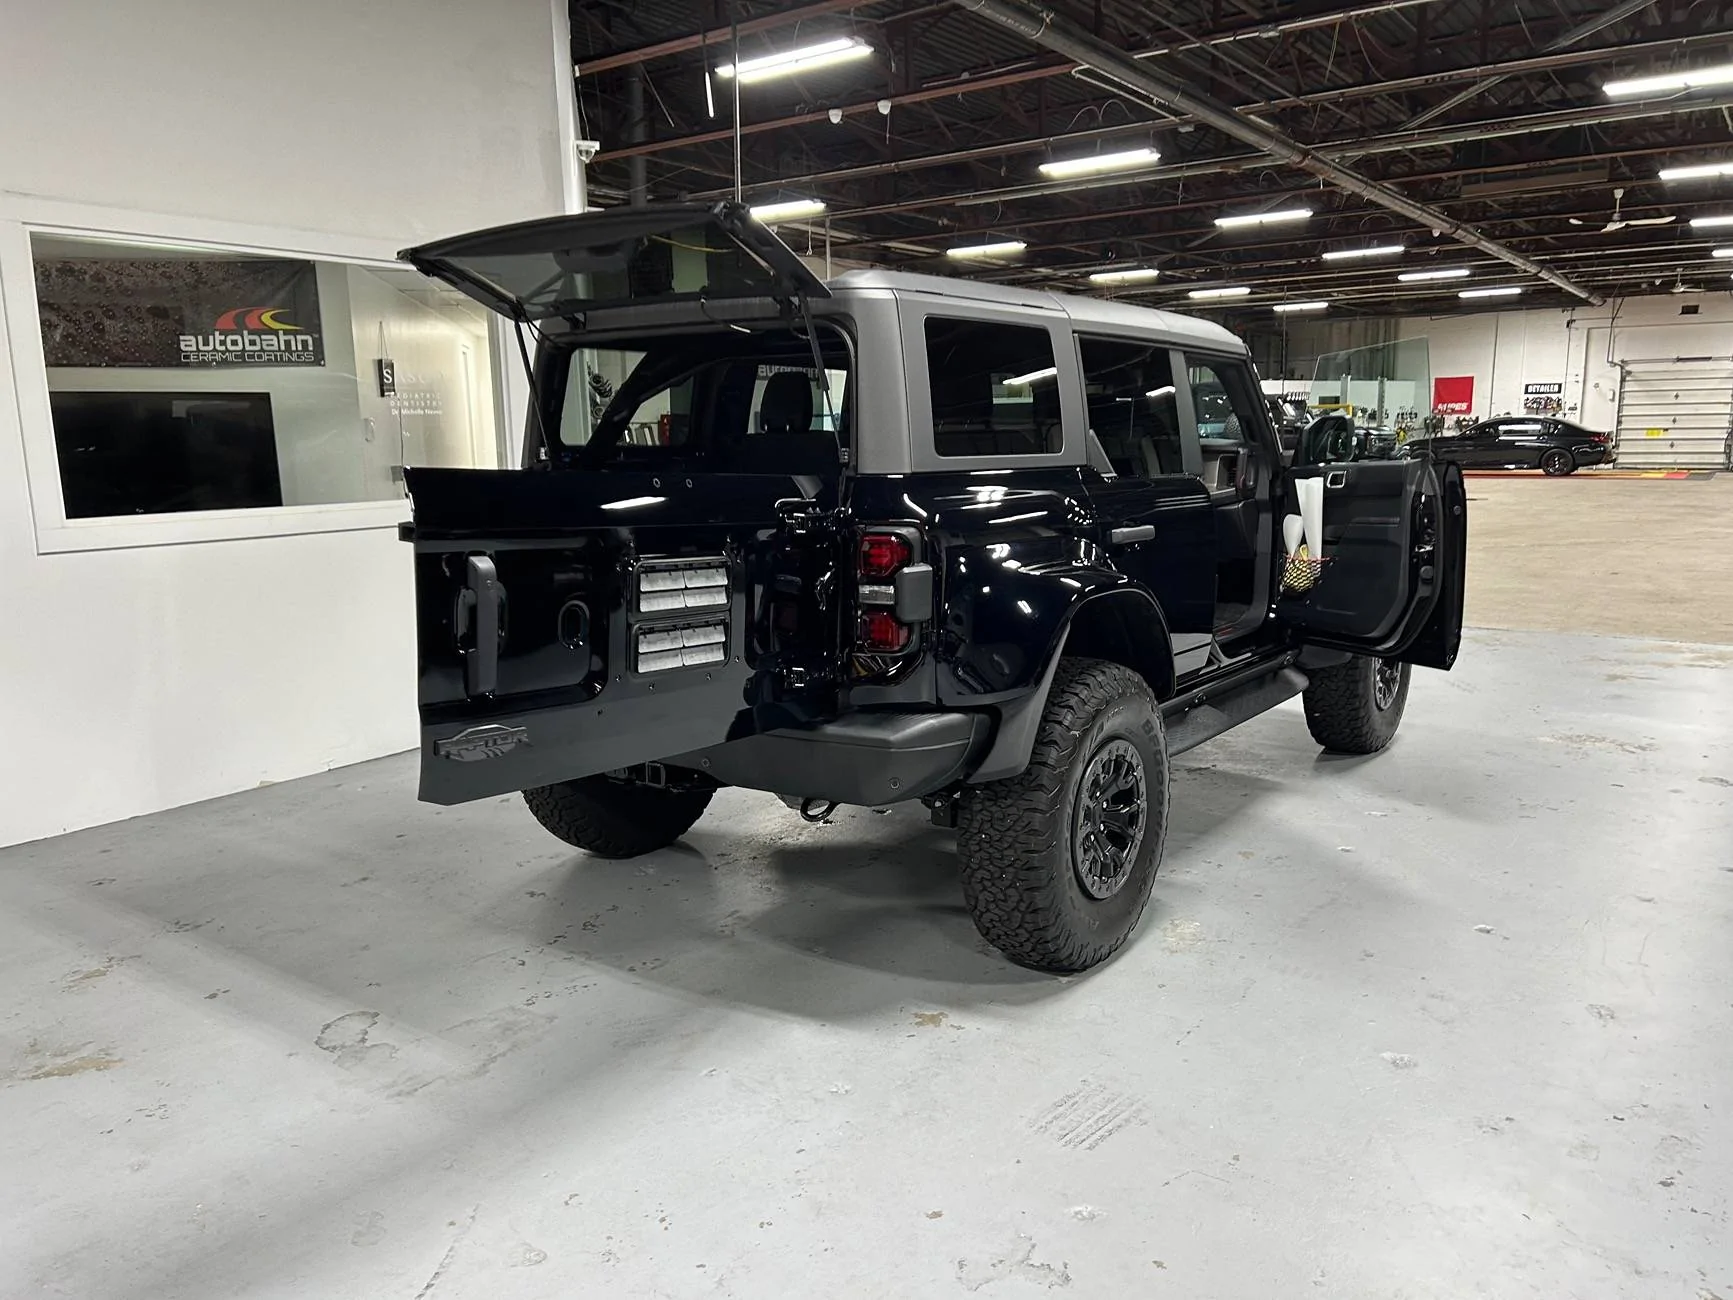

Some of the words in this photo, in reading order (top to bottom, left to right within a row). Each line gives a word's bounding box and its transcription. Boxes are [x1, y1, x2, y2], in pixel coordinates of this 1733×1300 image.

[179, 330, 314, 351] autobahn
[181, 352, 242, 362] CERAMIC
[245, 352, 315, 362] COATINGS
